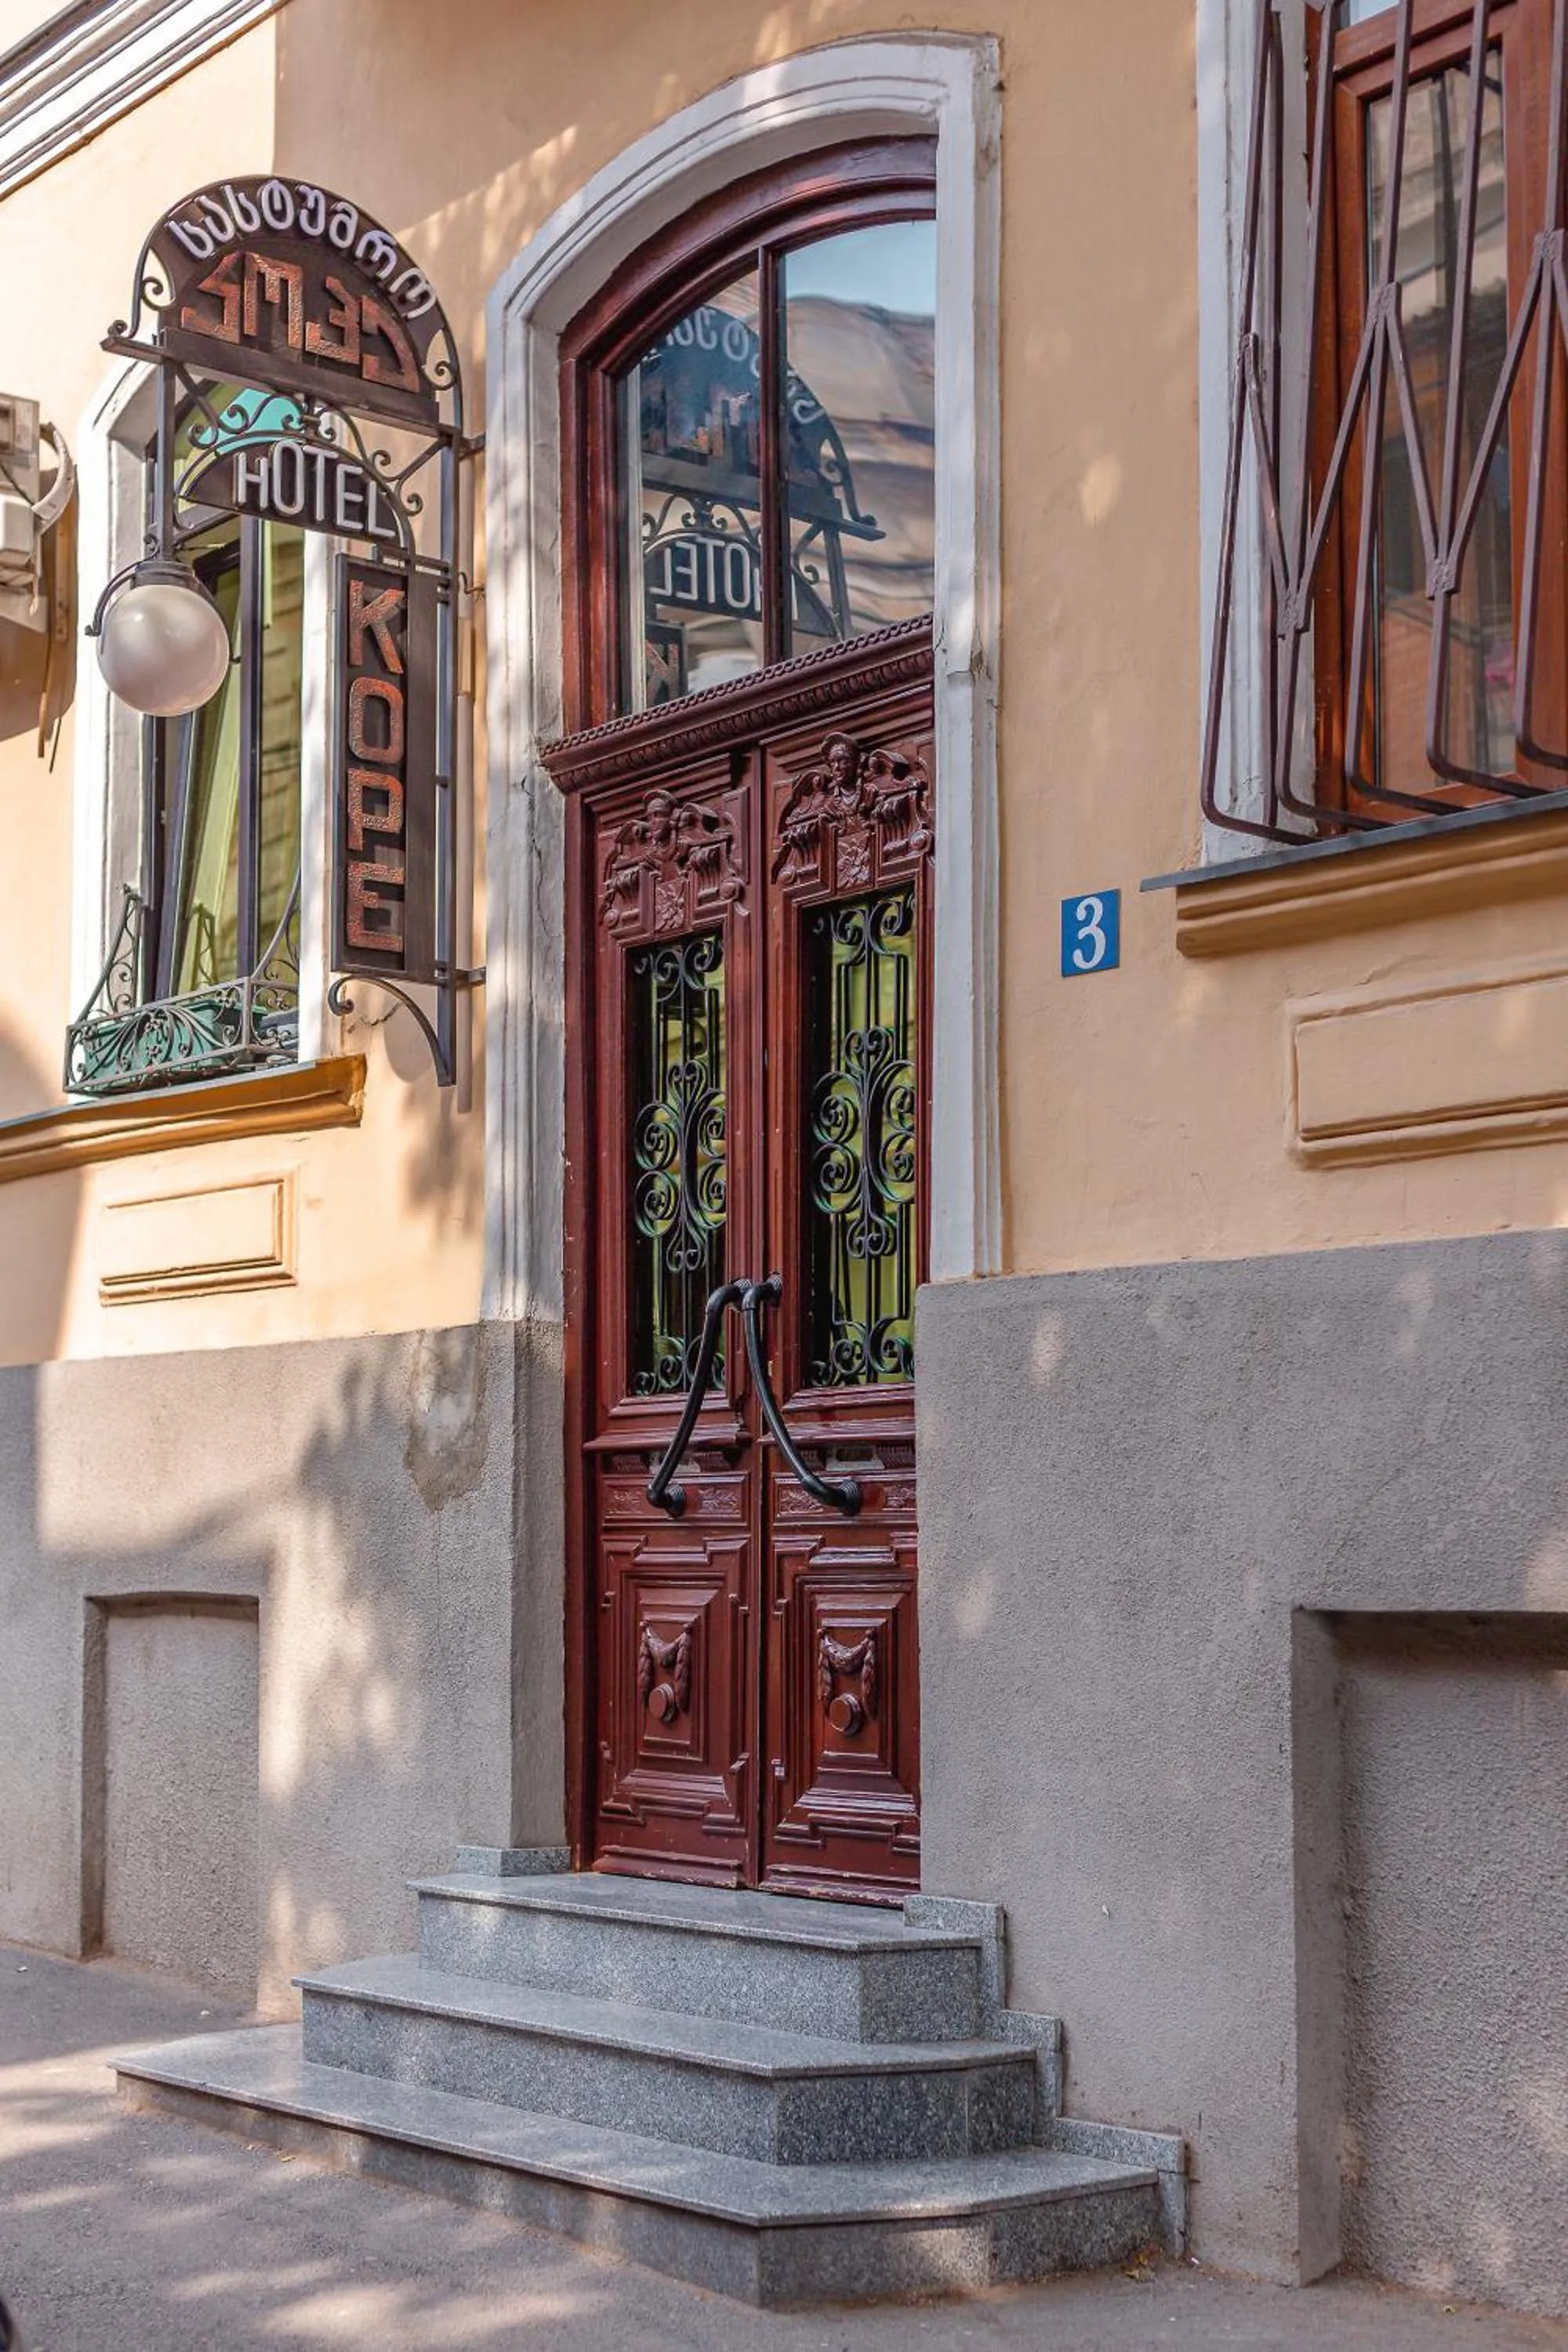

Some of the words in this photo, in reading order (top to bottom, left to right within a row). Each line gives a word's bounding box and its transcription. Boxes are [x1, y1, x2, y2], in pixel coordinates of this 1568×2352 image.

[165, 180, 437, 319] სასტუმრო
[181, 250, 420, 393] კოპე
[234, 440, 396, 538] HOTEL
[347, 579, 406, 953] KOPE
[1073, 897, 1106, 970] 3
